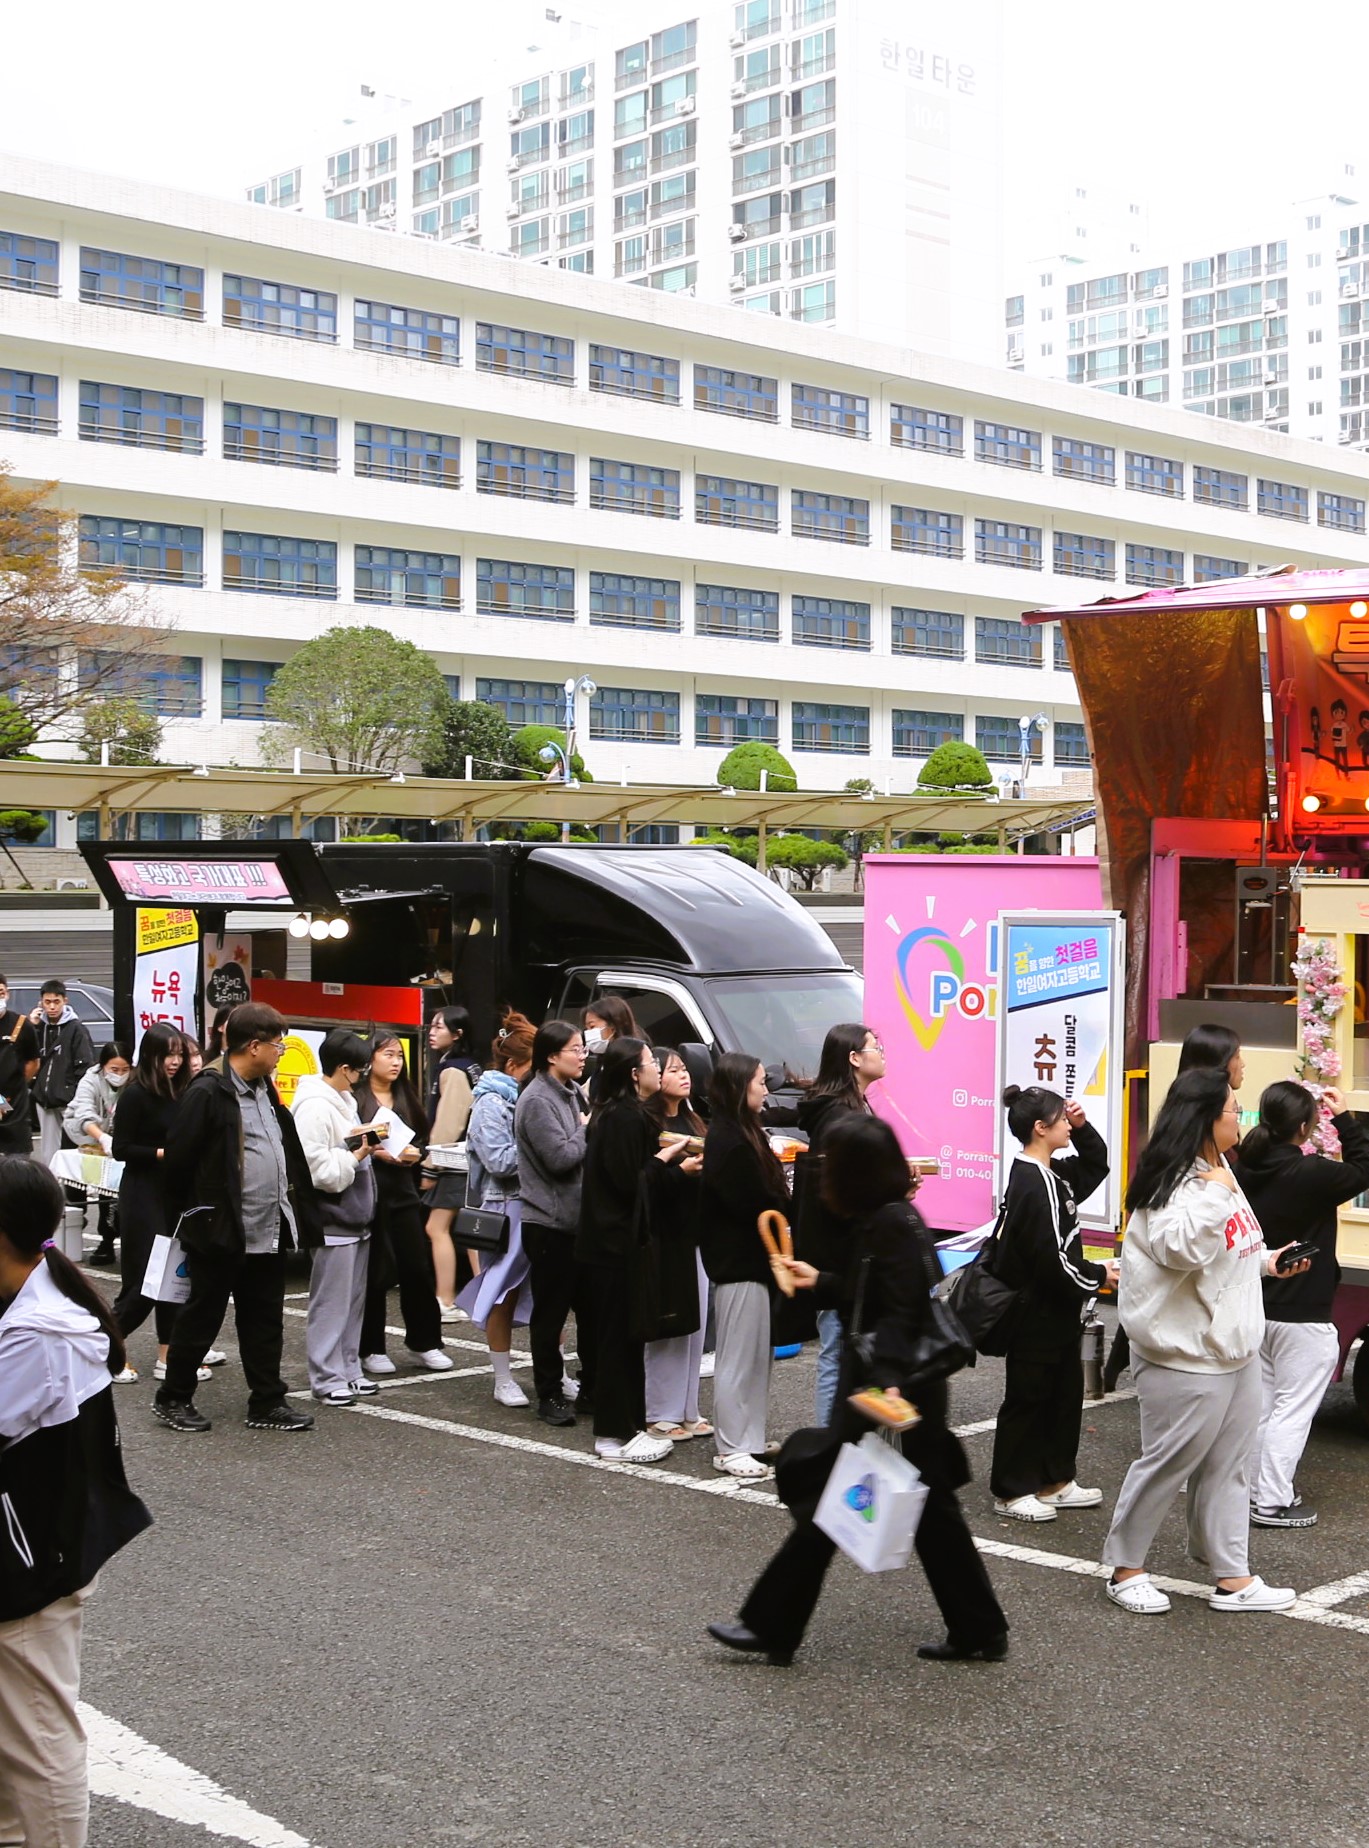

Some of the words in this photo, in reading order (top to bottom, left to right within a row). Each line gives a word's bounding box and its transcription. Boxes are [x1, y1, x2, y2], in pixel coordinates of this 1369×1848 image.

[880, 38, 976, 96] 한일타운
[133, 863, 191, 886] 특성화고
[188, 864, 249, 887] 국가대표
[1055, 938, 1097, 965] 첫걸음
[152, 970, 181, 1005] 뉴욕
[1016, 961, 1102, 995] 한일여자고등학교
[1064, 1014, 1077, 1057] 달콤
[971, 1096, 994, 1107] Porr
[956, 1167, 993, 1180] 010-40
